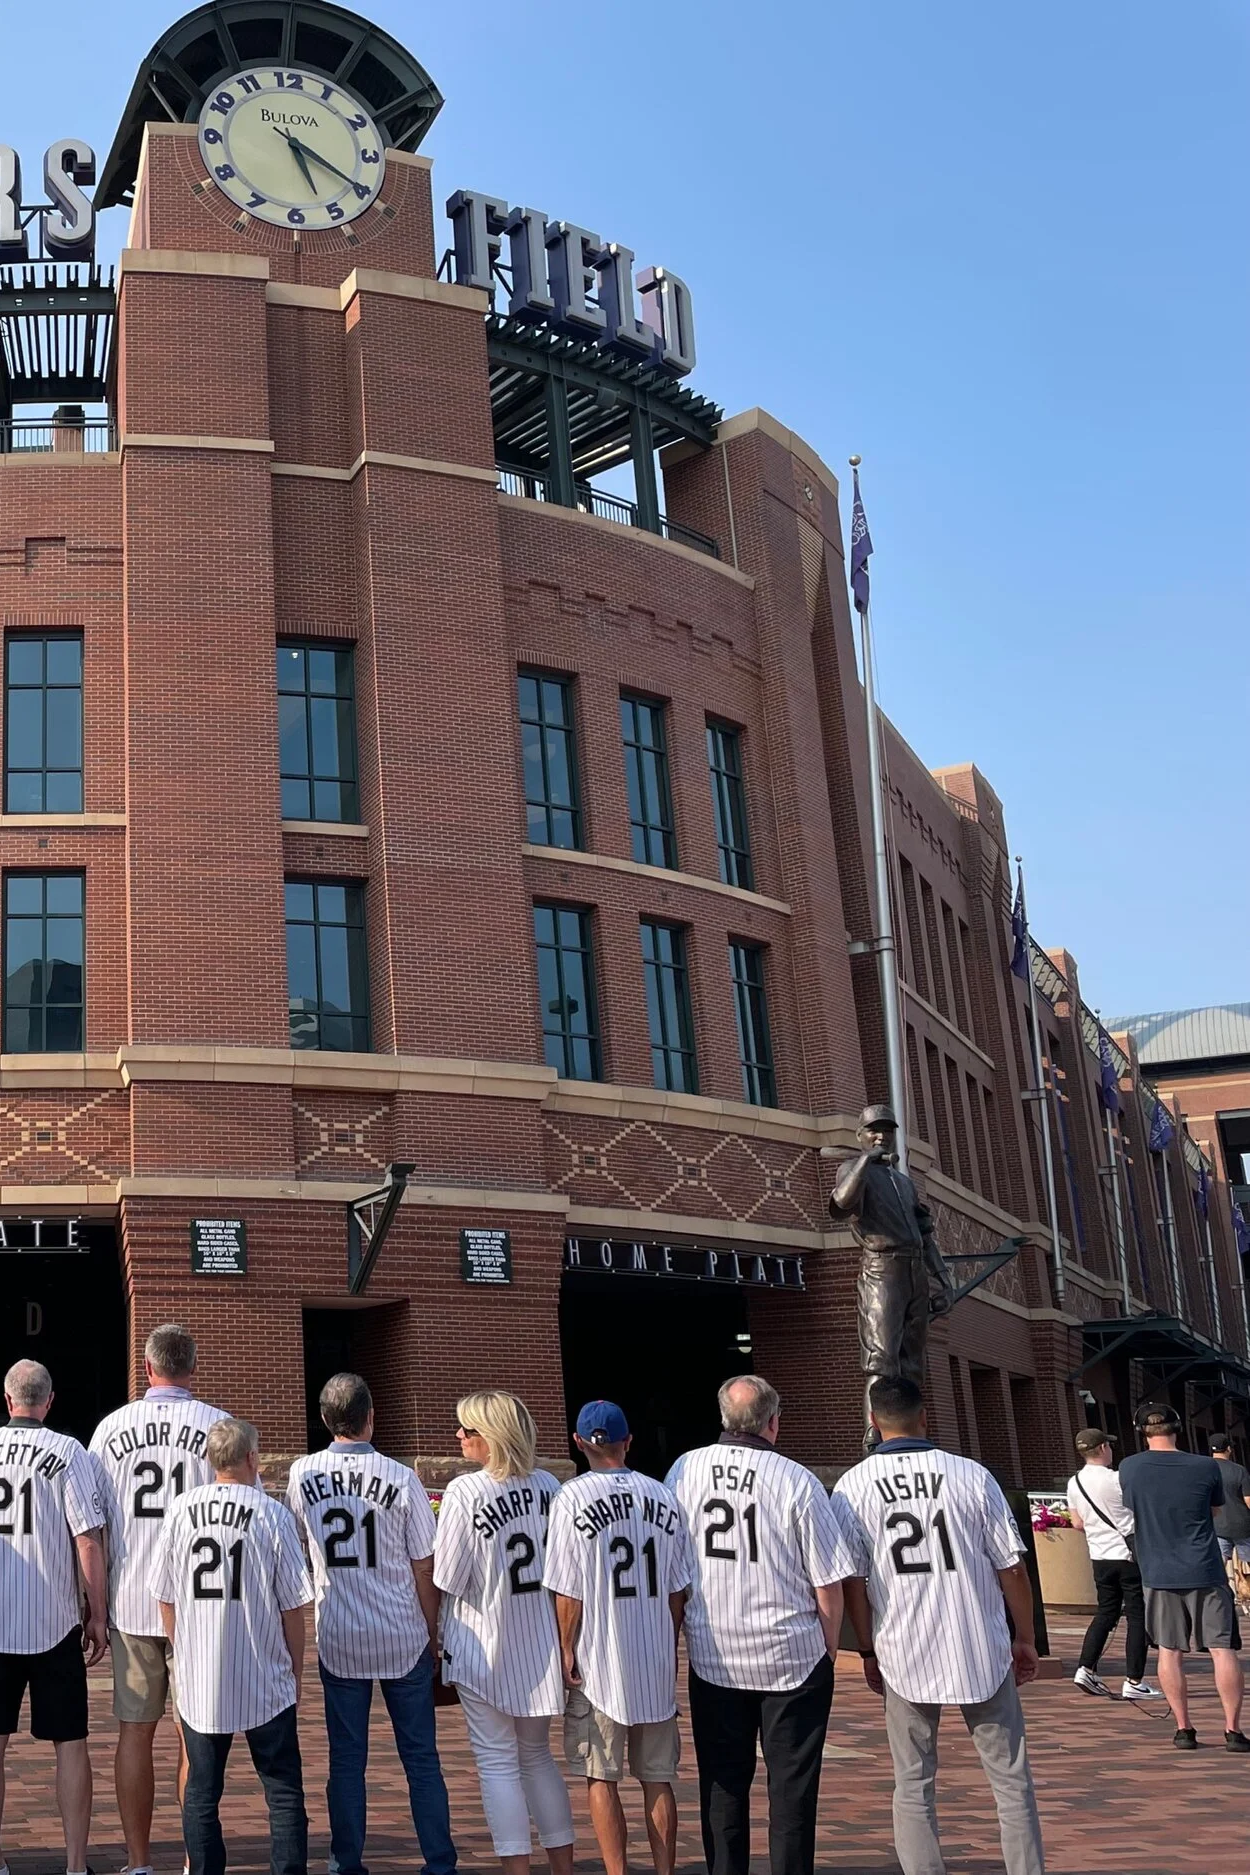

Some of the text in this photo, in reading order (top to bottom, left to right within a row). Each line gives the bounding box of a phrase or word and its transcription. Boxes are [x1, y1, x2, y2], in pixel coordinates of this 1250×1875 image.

[236, 76, 262, 94] 11
[274, 71, 303, 90] 12
[321, 85, 335, 100] 1
[209, 91, 235, 116] 10
[204, 128, 223, 145] 9
[347, 113, 368, 132] 2
[215, 163, 235, 181] 8
[361, 148, 380, 164] 3
[246, 192, 268, 209] 7
[352, 182, 372, 200] 4
[287, 208, 305, 225] 6
[326, 202, 345, 221] 5
[448, 189, 696, 375] FIELD
[568, 1239, 805, 1285] HOME PLATE
[108, 1422, 208, 1461] COLOR AR
[37, 1453, 66, 1480] AV
[712, 1464, 757, 1495] PSA
[134, 1461, 184, 1518] 21
[301, 1471, 399, 1510] HERMAN
[874, 1472, 944, 1504] USAV
[188, 1500, 254, 1532] VICOM
[474, 1488, 534, 1539] SHARP
[574, 1493, 678, 1540] SHARP NEC
[322, 1508, 376, 1568] 21
[704, 1499, 759, 1562] 21
[886, 1509, 956, 1574] 21
[192, 1537, 243, 1600] 21
[506, 1532, 548, 1595] 2
[609, 1536, 658, 1597] 21
